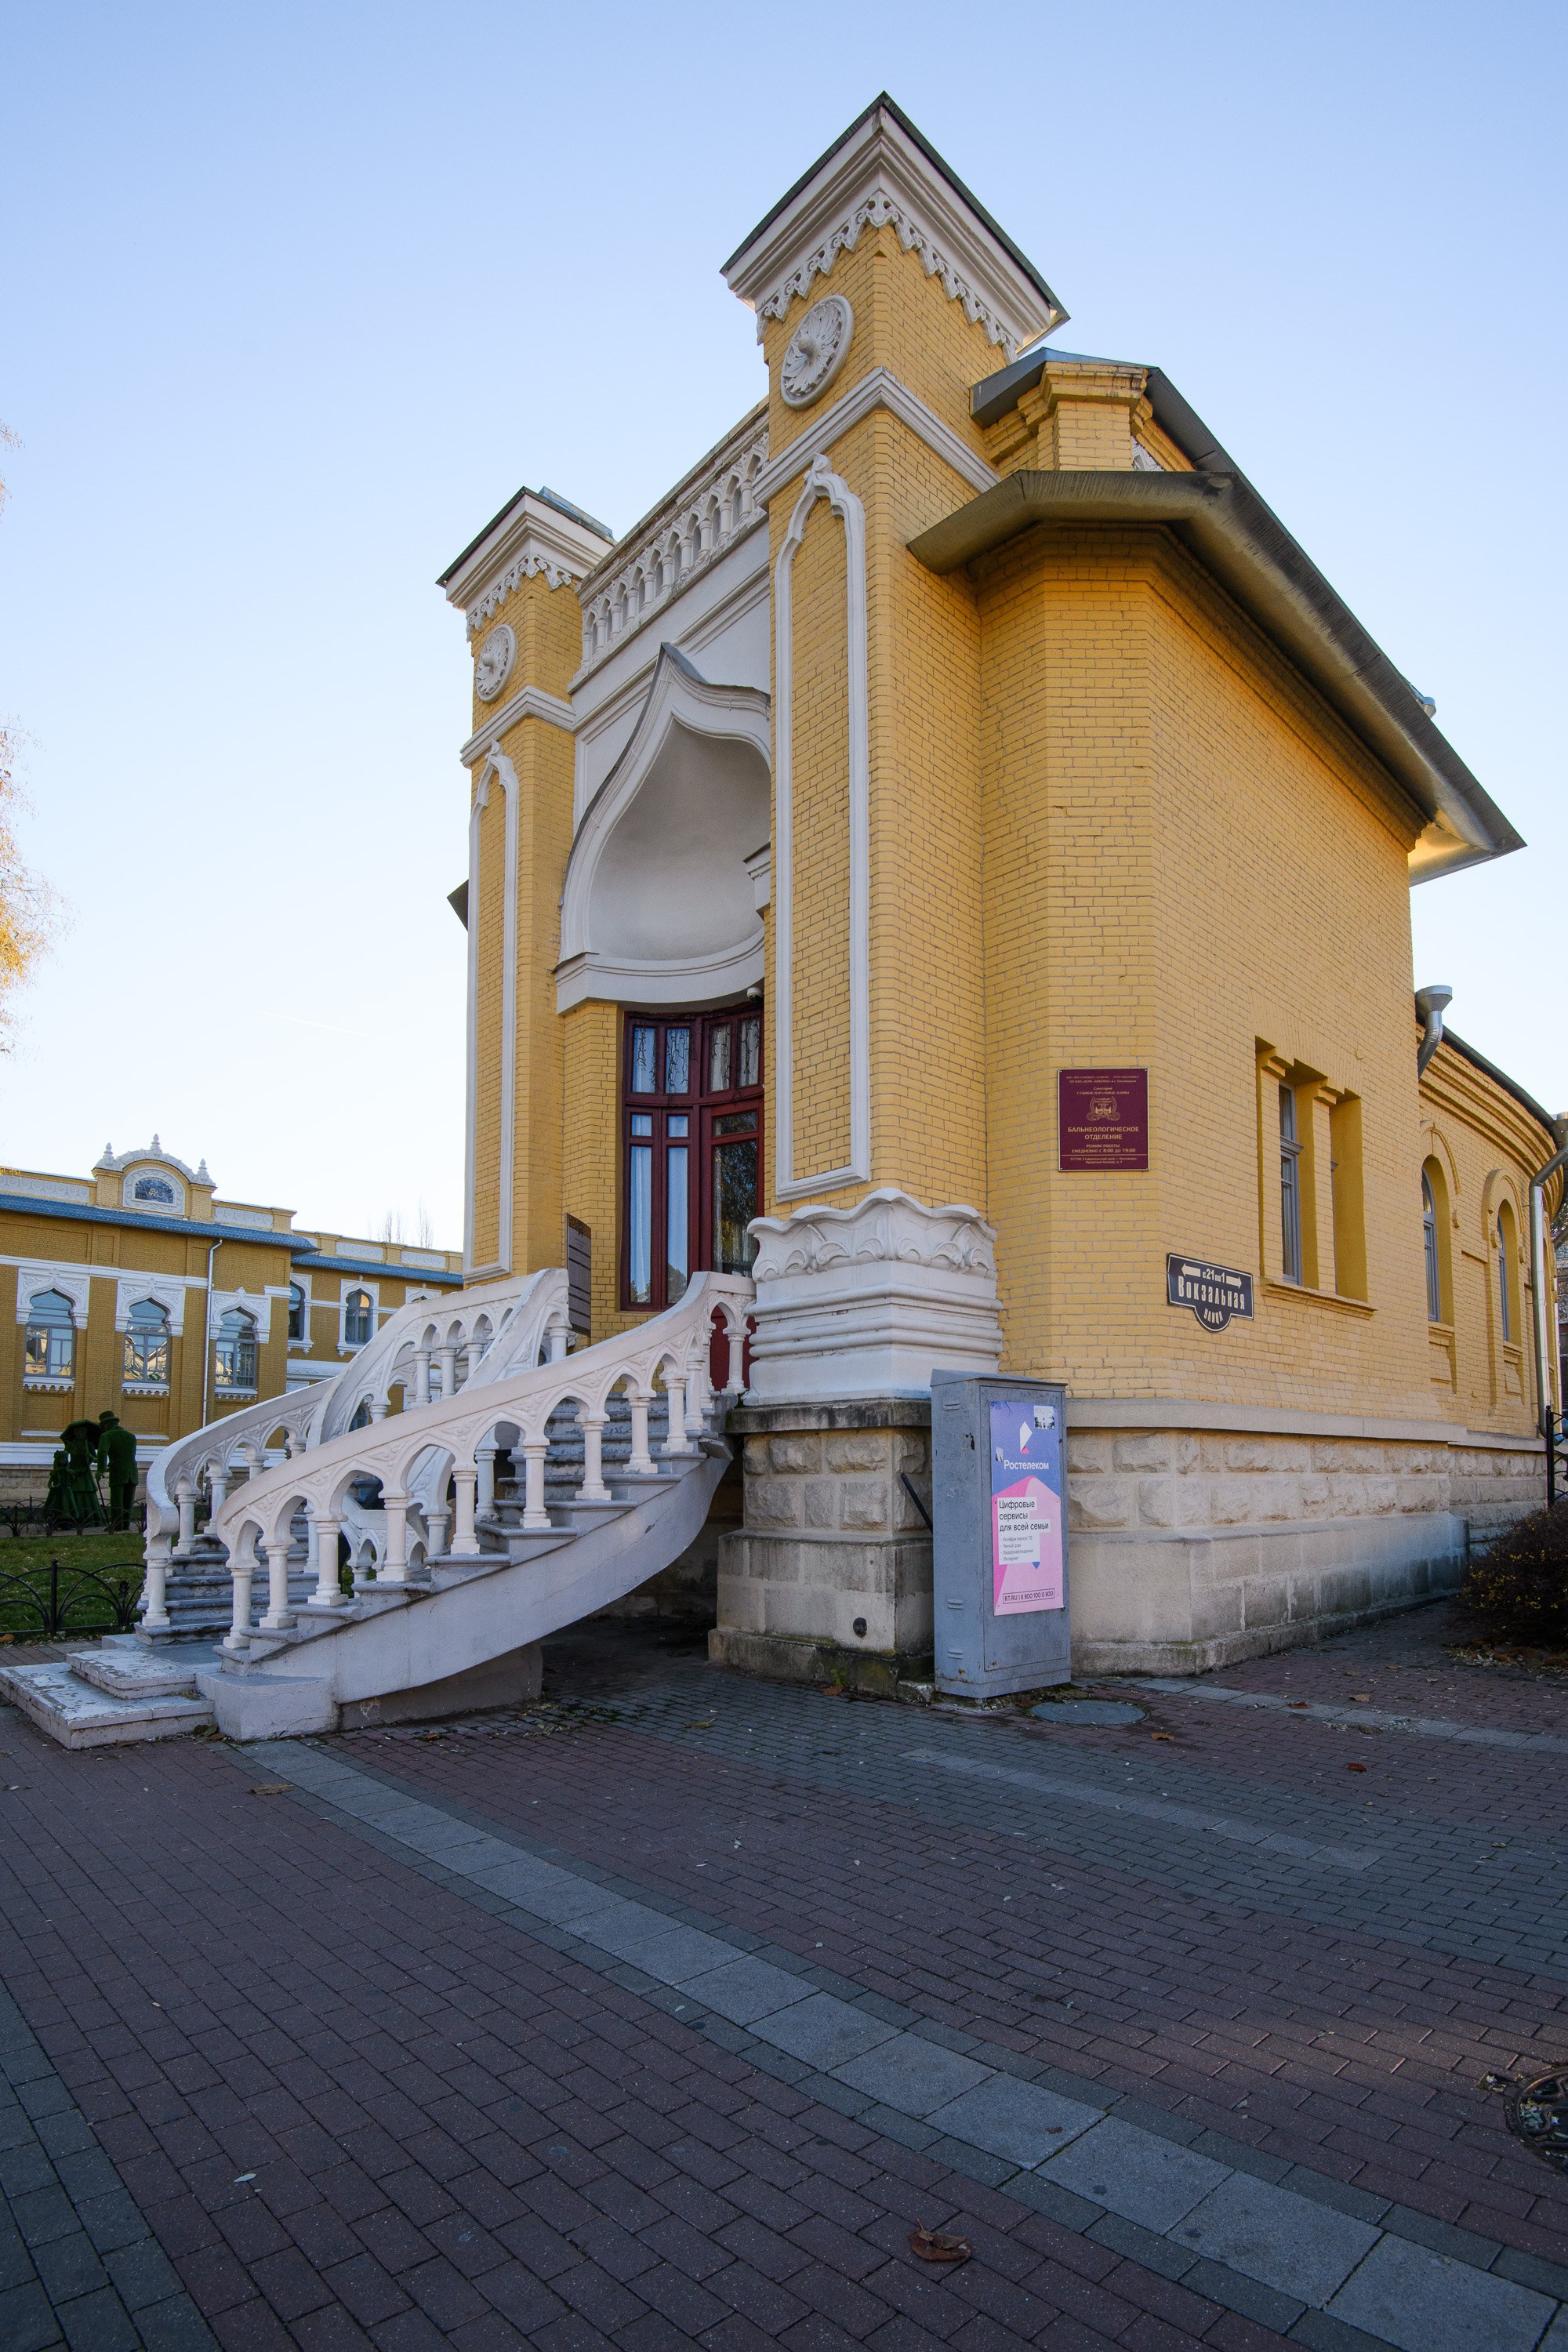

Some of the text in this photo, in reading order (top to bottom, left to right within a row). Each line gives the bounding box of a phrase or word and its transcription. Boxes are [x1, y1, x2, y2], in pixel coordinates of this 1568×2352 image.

[1178, 1275, 1244, 1310] Вокзальная
[1004, 1459, 1049, 1470] Ростелеком
[999, 1500, 1035, 1510] Цифровые
[999, 1513, 1028, 1522] сервисы
